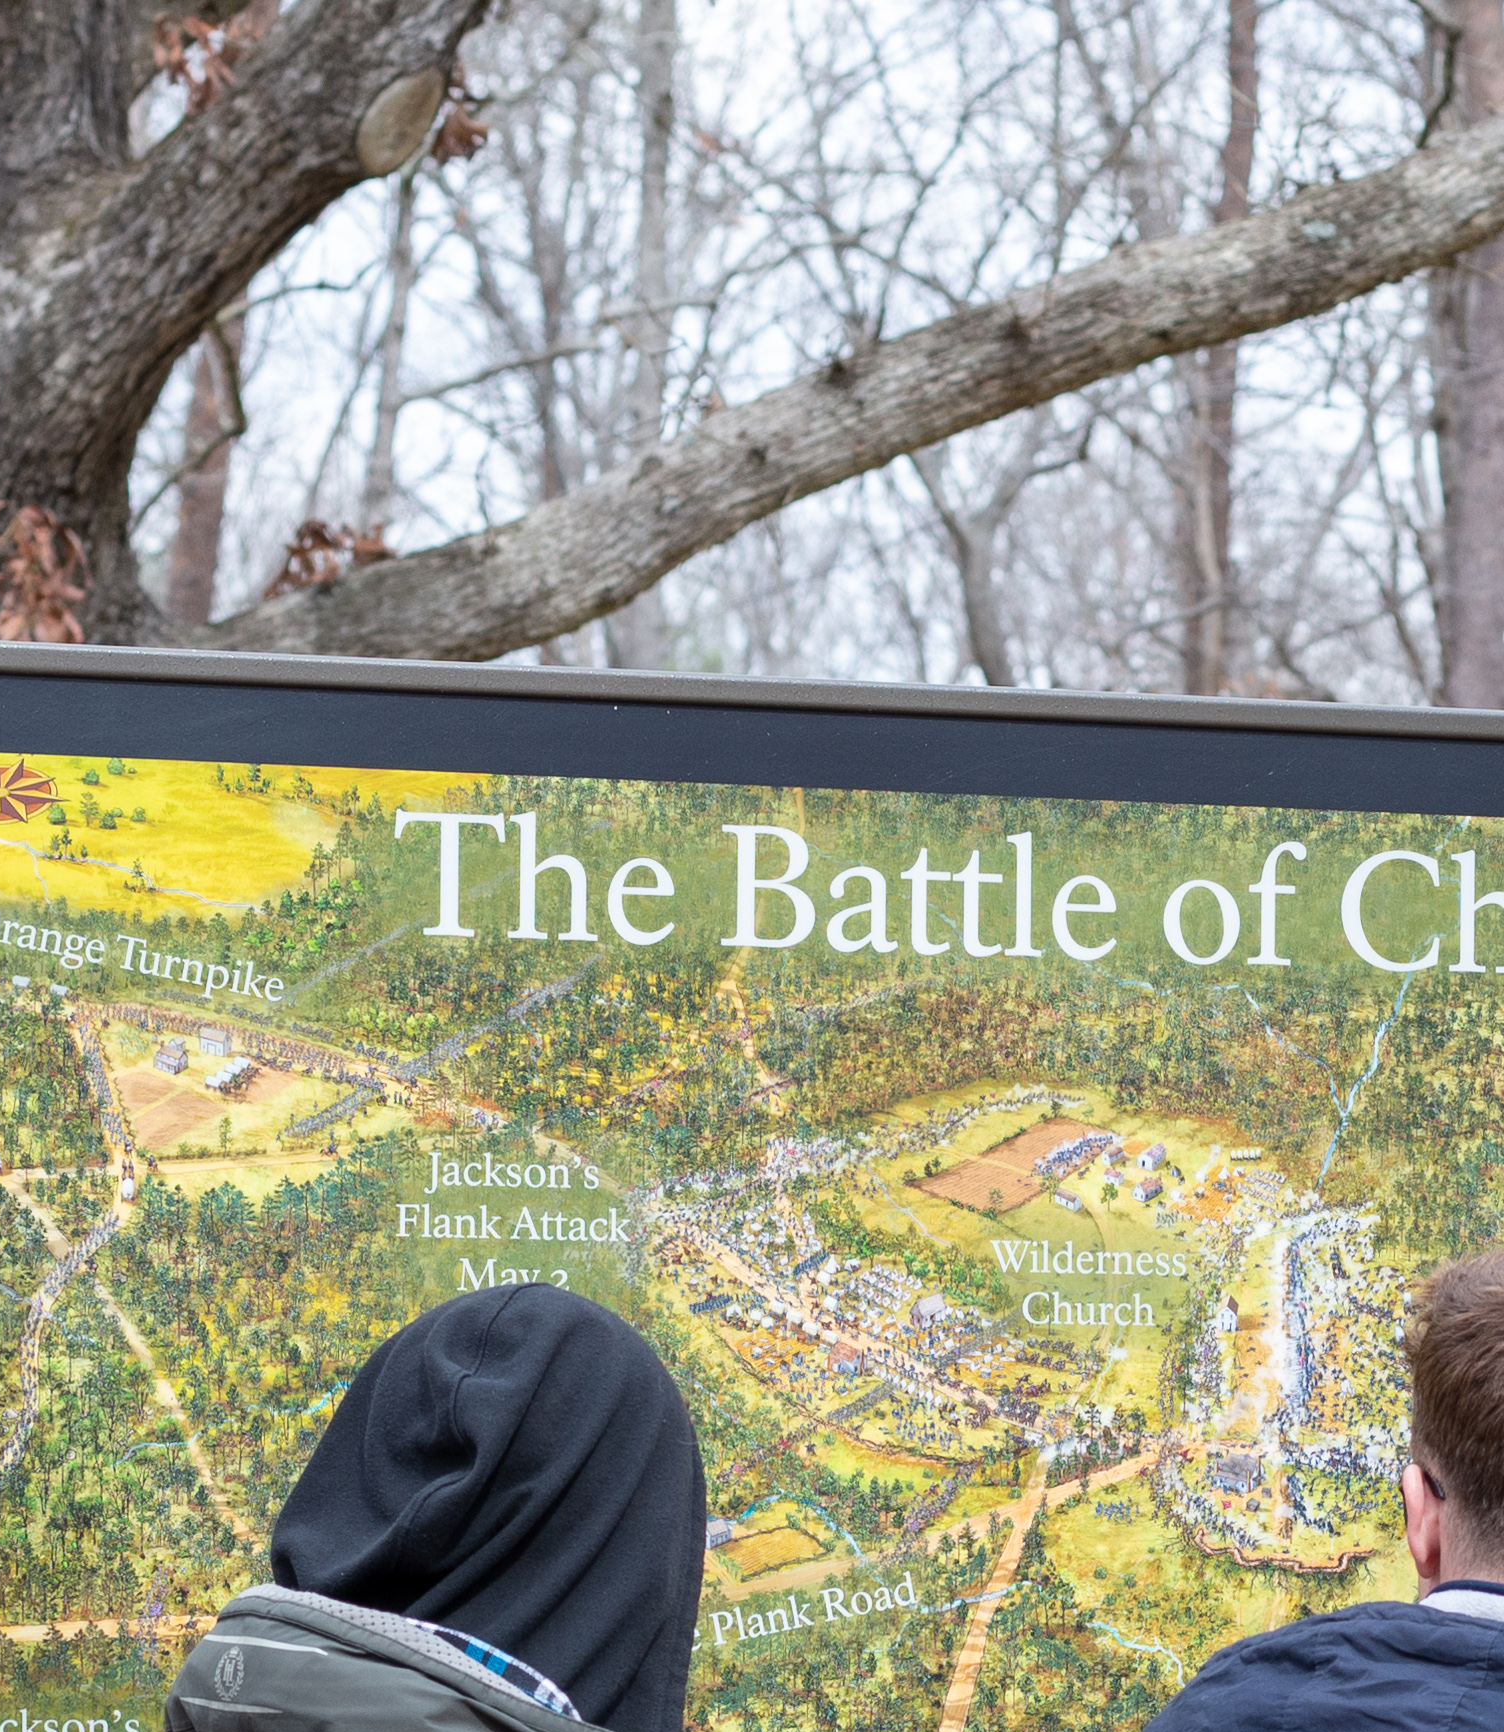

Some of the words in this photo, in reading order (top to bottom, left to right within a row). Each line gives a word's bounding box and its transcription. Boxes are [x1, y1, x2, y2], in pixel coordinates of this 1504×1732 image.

[393, 807, 677, 947] The
[720, 823, 1118, 962] Battle
[1162, 840, 1308, 967] of
[115, 934, 287, 1004] Turnpike
[423, 1151, 600, 1195] Jackson's
[395, 1203, 502, 1240] Flank
[510, 1205, 632, 1243] Attack
[990, 1237, 1188, 1278] Wilderness
[1021, 1291, 1155, 1331] Church
[708, 1595, 815, 1647] Plank
[819, 1570, 919, 1624] Road
